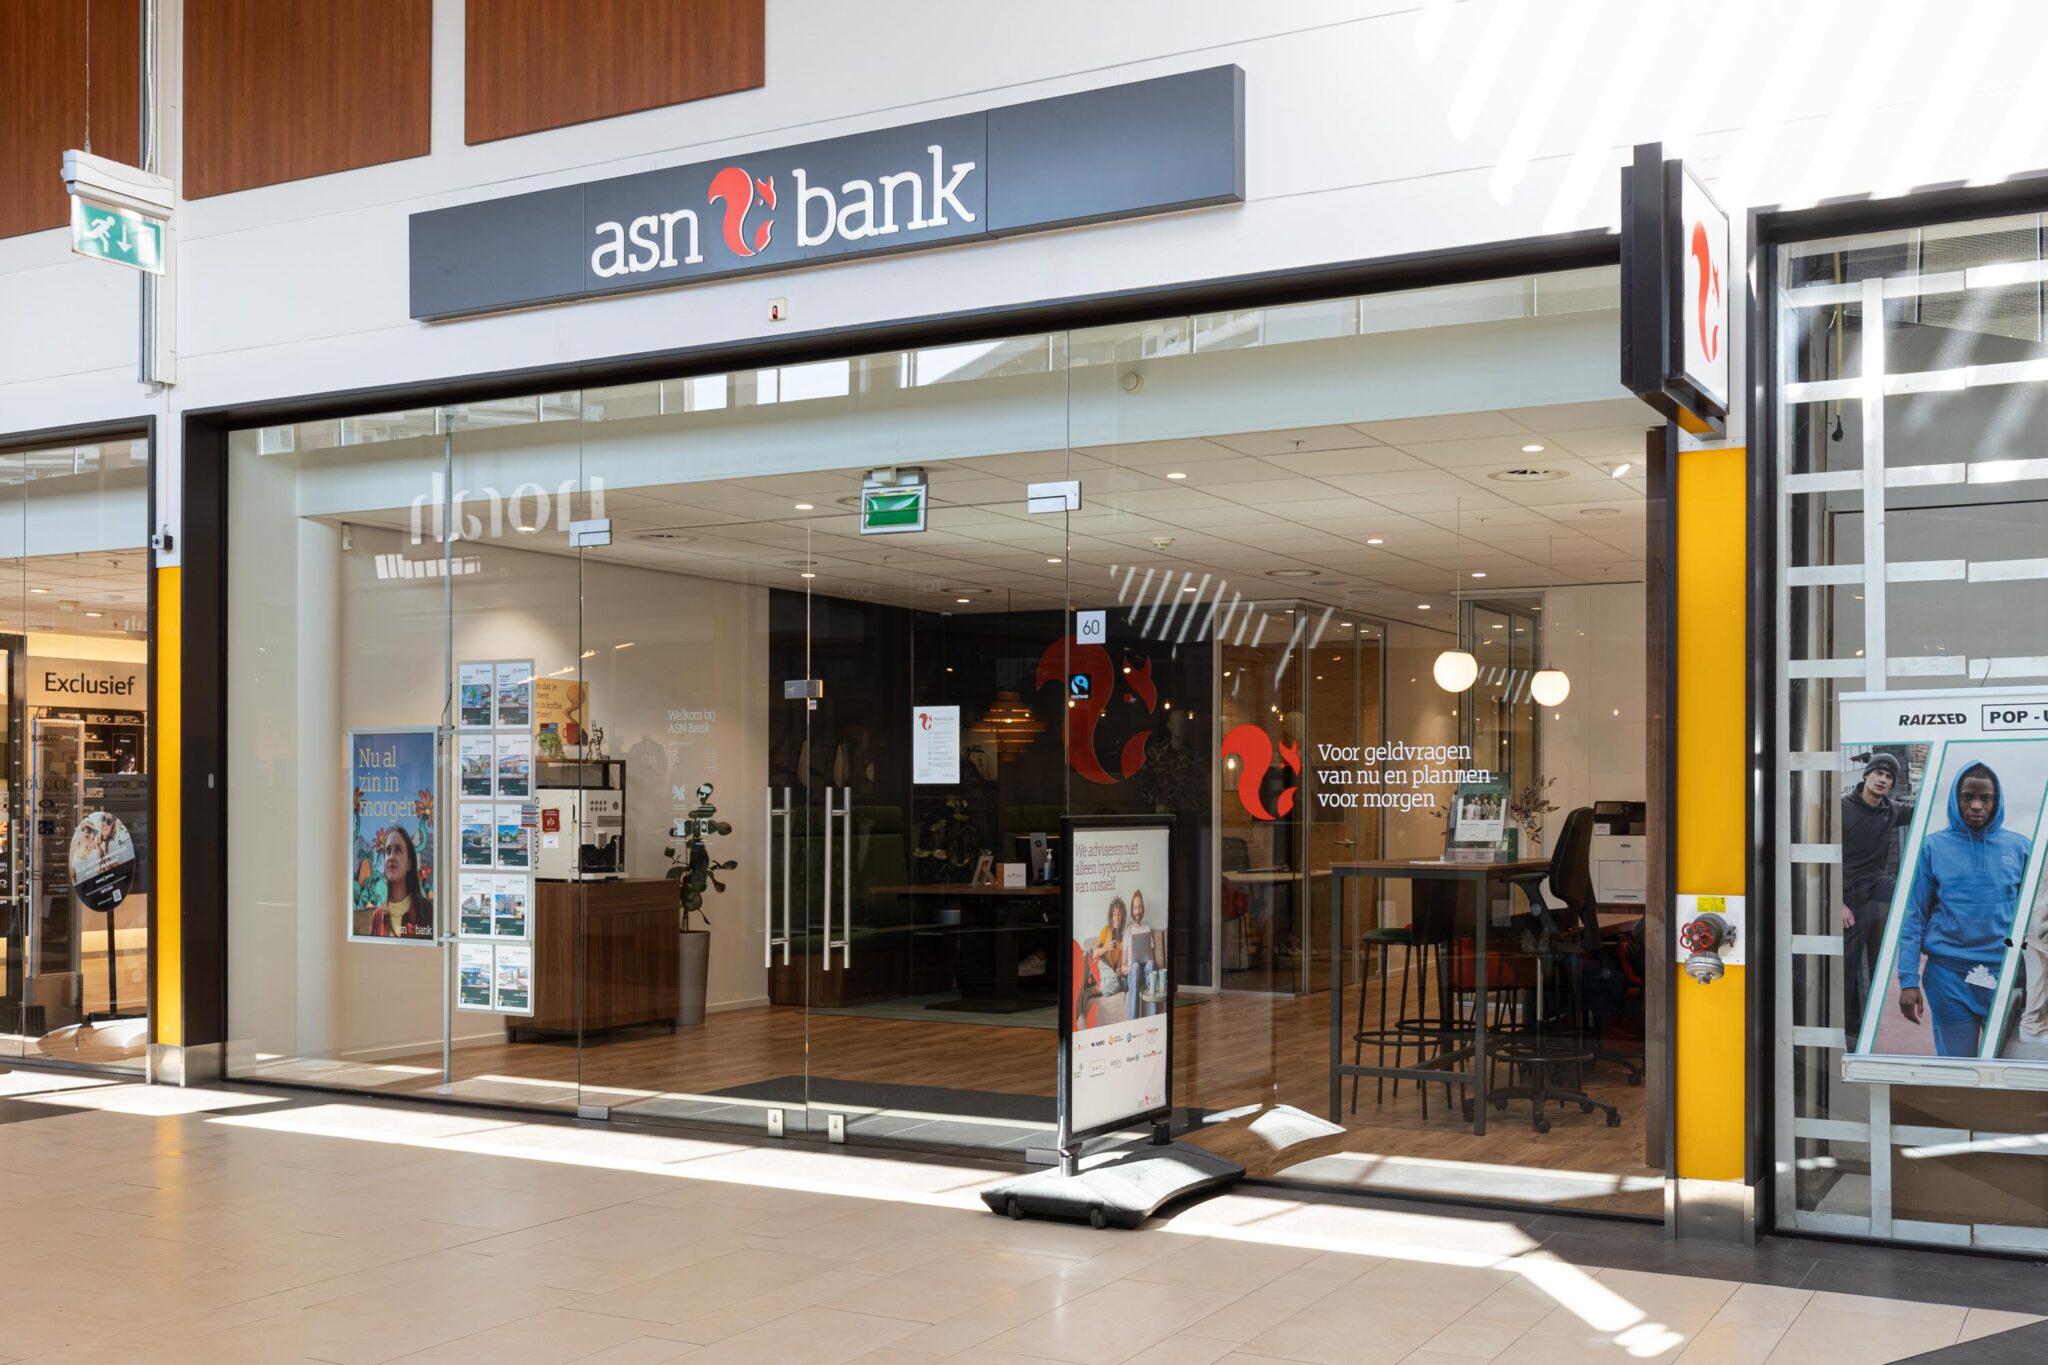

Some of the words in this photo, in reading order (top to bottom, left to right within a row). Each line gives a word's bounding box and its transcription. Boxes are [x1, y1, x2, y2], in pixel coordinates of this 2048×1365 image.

[591, 208, 704, 277] asn
[792, 144, 976, 247] bank
[1082, 619, 1100, 635] 60
[45, 672, 135, 695] Exclusief
[668, 709, 702, 720] Welkom
[704, 709, 716, 721] bij
[1990, 711, 2028, 723] POP
[668, 723, 687, 734] ASN
[688, 723, 711, 733] Bank
[359, 749, 380, 768] Nu
[383, 746, 396, 768] al
[1318, 744, 1360, 761] Voor
[1364, 741, 1471, 765] geldvragen
[359, 772, 382, 792] zin
[384, 771, 399, 792] in
[1318, 770, 1352, 784] van
[1356, 770, 1380, 784] nu
[1384, 769, 1407, 784] en
[1412, 765, 1491, 788] plannen
[359, 800, 417, 822] morgen
[1318, 793, 1359, 807] voor
[1363, 793, 1435, 812] morgen
[1075, 844, 1087, 857] We
[1089, 842, 1123, 856] adviseren
[1125, 843, 1139, 855] niet
[1075, 861, 1096, 875] alleen
[1098, 858, 1140, 877] hypotheken
[1075, 882, 1089, 892] van
[1090, 876, 1116, 891] onszelf
[415, 925, 432, 935] bank
